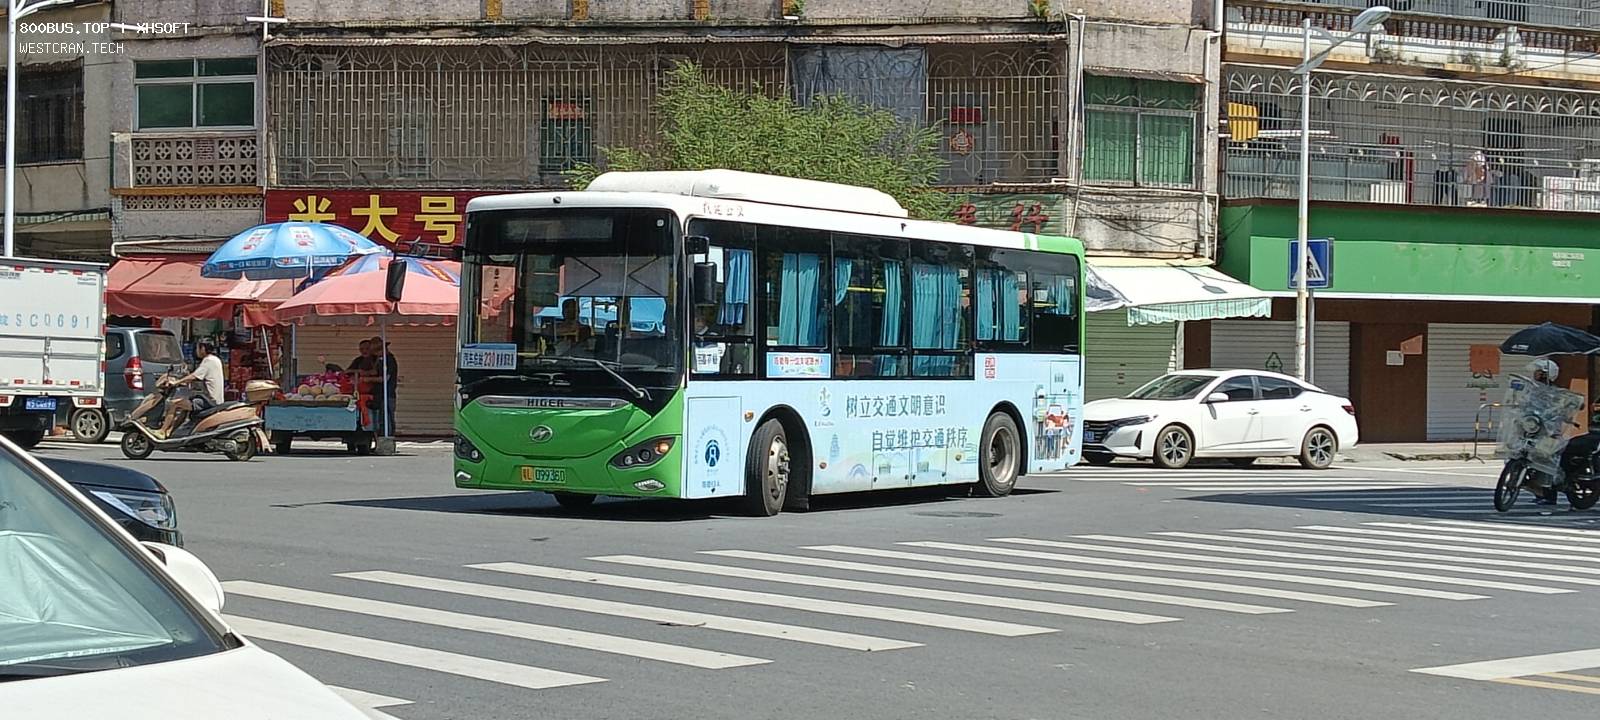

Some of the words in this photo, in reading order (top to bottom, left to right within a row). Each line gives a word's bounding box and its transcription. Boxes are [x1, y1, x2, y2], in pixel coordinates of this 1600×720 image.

[527, 398, 564, 408] HIGER
[846, 395, 946, 419] 树立交通文明意识
[872, 426, 968, 452] 自觉维护交通秩序
